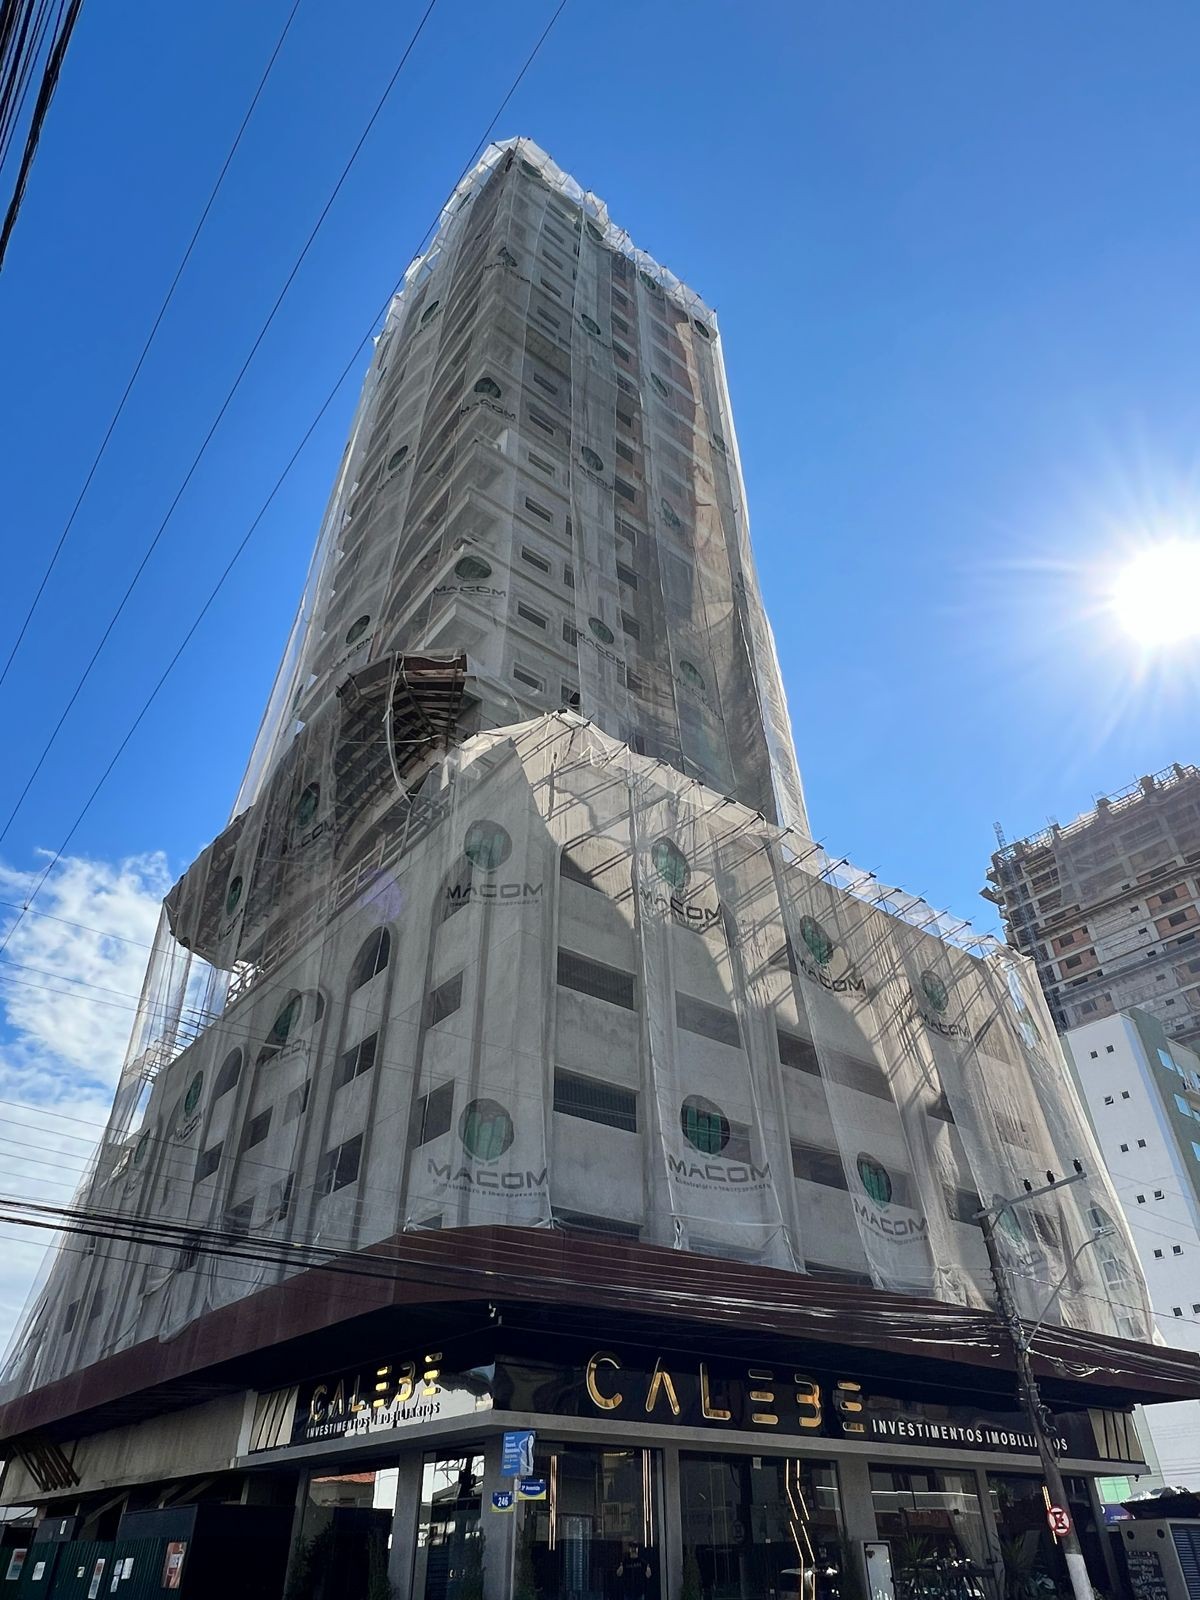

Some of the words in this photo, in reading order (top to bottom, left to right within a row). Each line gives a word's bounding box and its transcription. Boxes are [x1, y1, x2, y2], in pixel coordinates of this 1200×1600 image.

[433, 585, 507, 598] MACOM
[446, 882, 544, 900] MACOM
[640, 887, 721, 921] MACOM
[428, 1158, 548, 1190] MACOM
[669, 1154, 773, 1183] MACOM
[853, 1197, 930, 1236] MACOM
[585, 1350, 866, 1434] CALEBE
[306, 1415, 371, 1439] INVESTIMENTOS
[872, 1418, 983, 1444] INVESTIMENTOS
